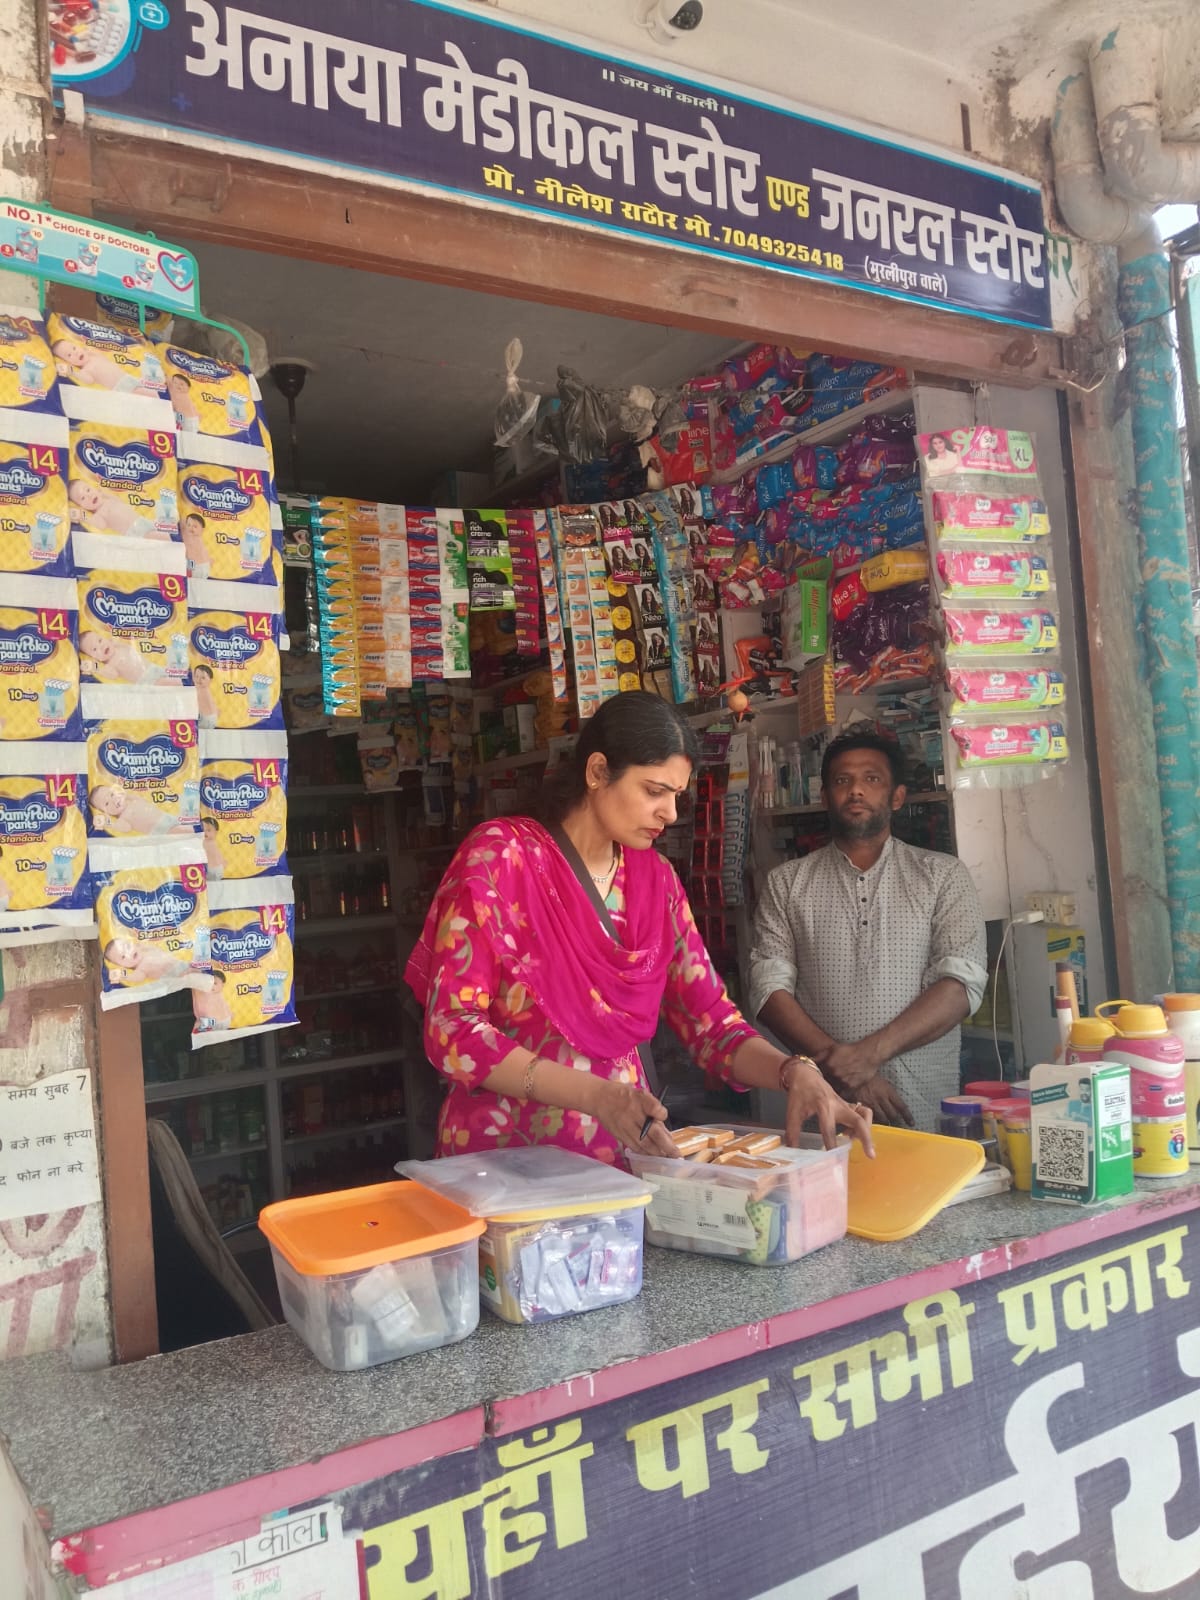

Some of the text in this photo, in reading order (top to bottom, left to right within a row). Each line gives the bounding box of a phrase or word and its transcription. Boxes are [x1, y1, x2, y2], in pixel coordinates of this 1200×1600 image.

[619, 74, 649, 92] जय
[652, 84, 674, 99] माँ
[675, 91, 719, 112] काली
[185, 0, 1045, 289] अनाया मेडीकल स्टोर एण्ड जनरल स्टोर
[534, 177, 614, 215] नीलेश
[620, 201, 679, 231] राठौर
[53, 221, 90, 238] CHOICE
[93, 231, 105, 241] OF
[107, 236, 150, 256] DOCTORS
[91, 331, 122, 341] pants
[86, 340, 127, 352] Standard
[85, 447, 158, 473] MamyPoko
[1015, 448, 1029, 462] XL
[108, 465, 138, 479] pants
[101, 479, 143, 492] Standard
[189, 482, 249, 505] MamyPoko
[207, 498, 233, 510] pants
[203, 510, 238, 521] Standard
[96, 591, 170, 617] MamyPoko
[119, 611, 149, 625] pants
[112, 628, 155, 639] Standard
[198, 633, 257, 653] MamyPoko
[216, 648, 241, 658] pants
[211, 660, 245, 670] Standard
[107, 744, 181, 768] MamyPoko
[130, 764, 161, 776] pants
[123, 778, 167, 789] Standard
[204, 781, 265, 800] MamyPoko
[223, 797, 248, 808] pants
[7, 818, 40, 830] pants
[120, 896, 192, 920] MamyPoko
[143, 910, 173, 924] pants
[138, 927, 181, 940] Standard
[212, 934, 271, 955] MamyPoko
[229, 947, 254, 958] pants
[224, 961, 260, 971] Standard
[8, 1075, 87, 1100] समय सुबह 7
[10, 1136, 30, 1150] बजे
[37, 1133, 56, 1147] तक
[17, 1169, 40, 1183] फोन
[48, 1166, 61, 1178] ना
[626, 1378, 769, 1499] पर
[793, 1290, 975, 1442] सभी
[997, 1224, 1191, 1367] प्रकार
